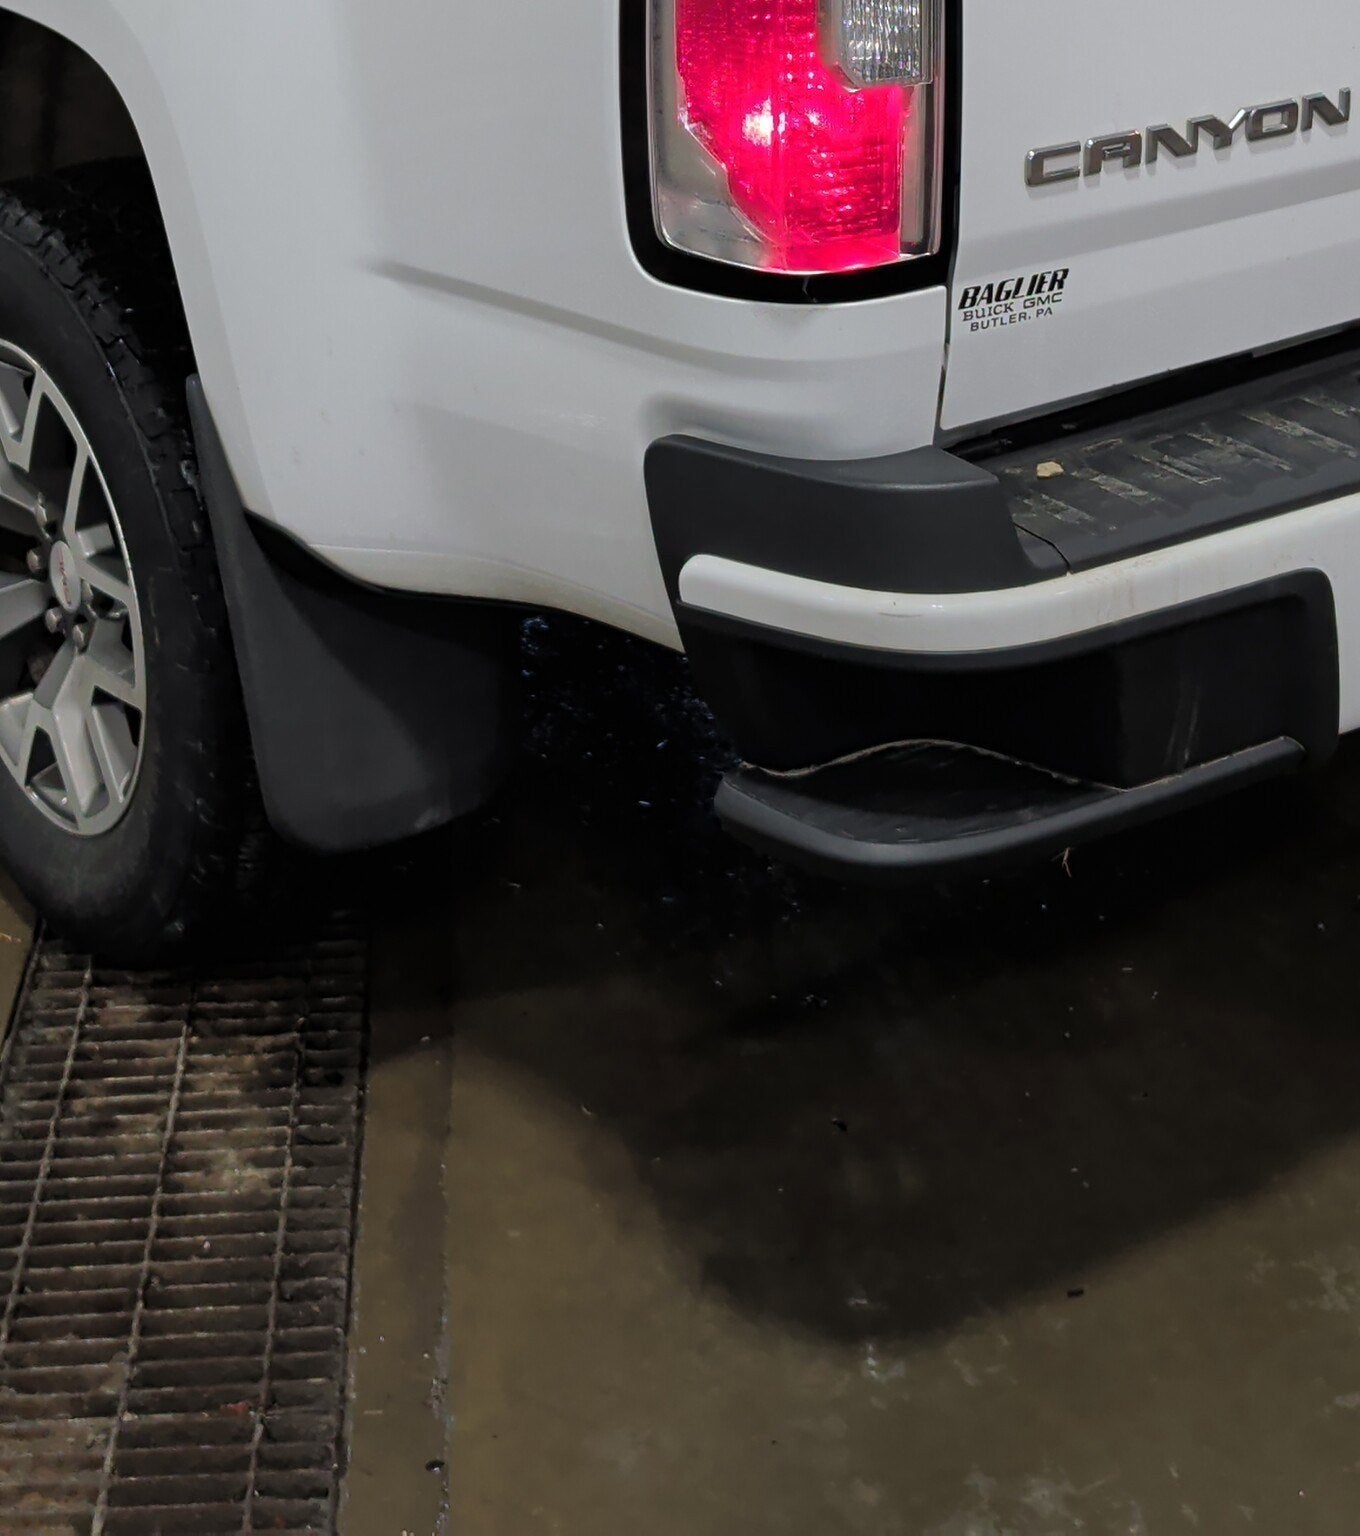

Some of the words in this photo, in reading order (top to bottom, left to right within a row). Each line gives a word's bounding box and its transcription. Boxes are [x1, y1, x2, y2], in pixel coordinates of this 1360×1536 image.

[1024, 87, 1351, 187] CANYON
[957, 267, 1070, 310] BAGLIER
[962, 301, 1015, 322] BUICK
[1022, 291, 1063, 310] GMC
[1036, 306, 1053, 319] PA
